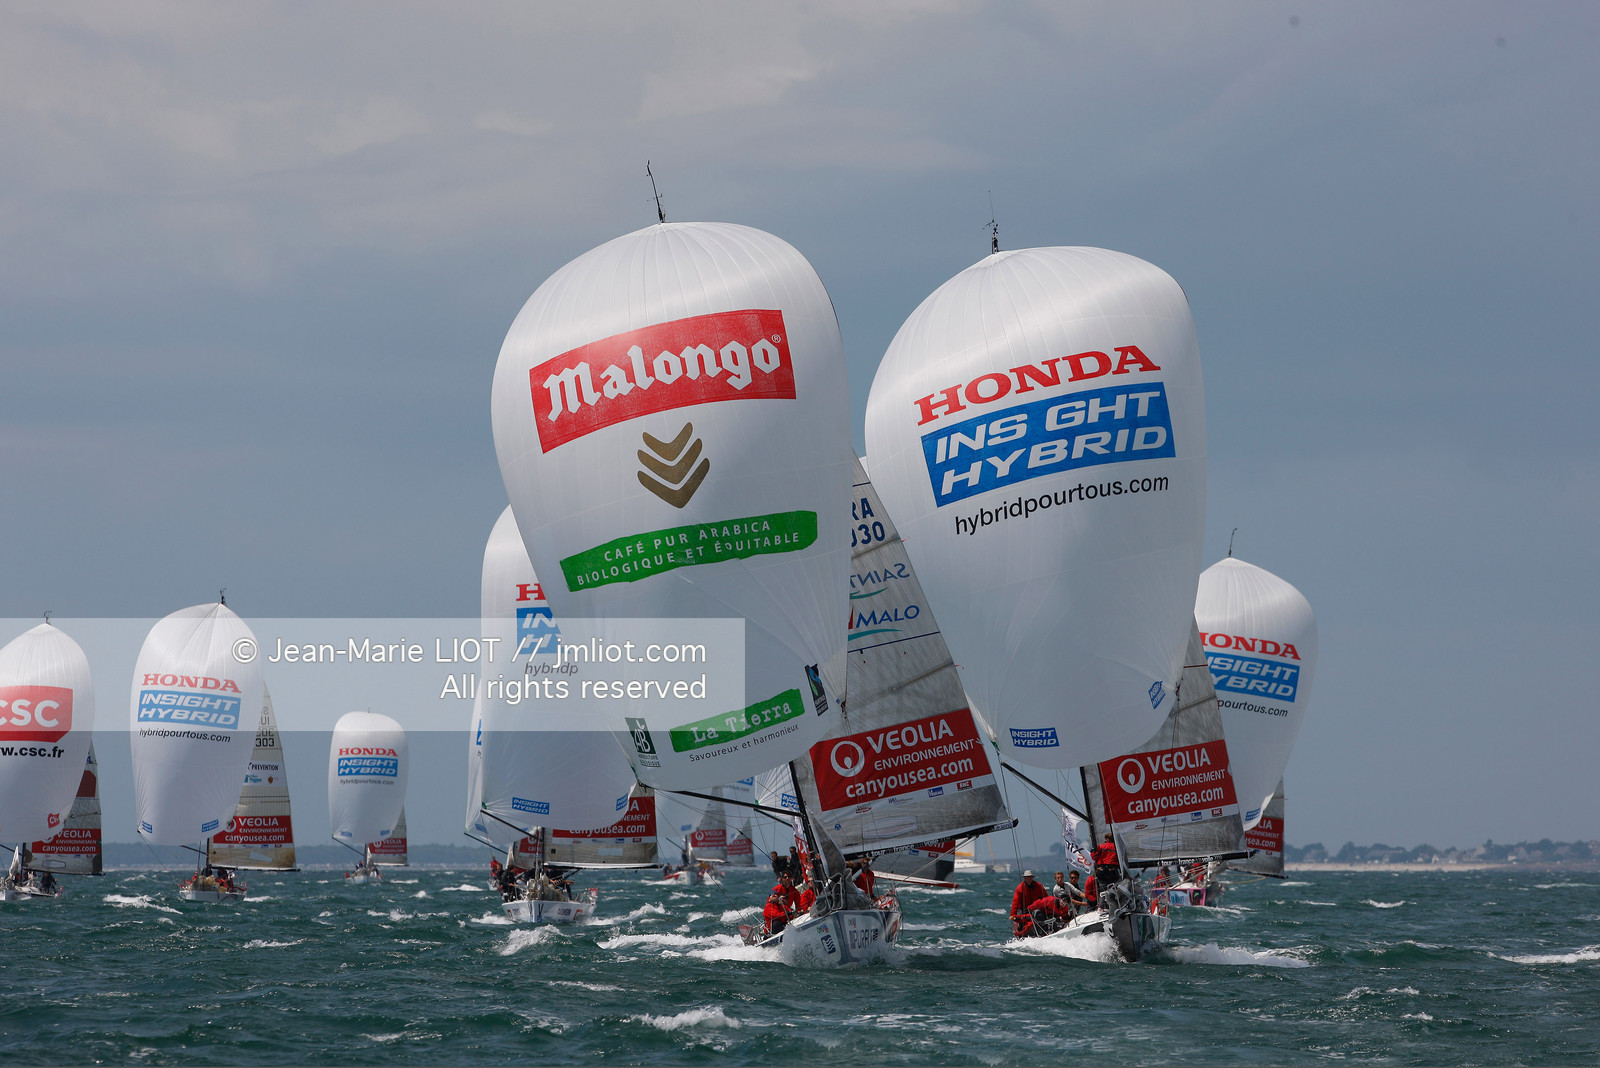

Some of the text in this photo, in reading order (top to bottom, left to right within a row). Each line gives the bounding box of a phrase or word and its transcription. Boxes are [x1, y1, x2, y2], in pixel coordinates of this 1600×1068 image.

[914, 345, 1161, 426] HONDA
[941, 426, 1167, 496] HYBRID
[955, 476, 1169, 535] hybridpourtous.com
[604, 520, 771, 562] CAFÉ PUR ARABICA
[577, 532, 799, 586] BIOLOGIQUE ET ÉQUITABLE
[856, 605, 920, 628] MALO
[142, 673, 241, 693] HONDA
[141, 693, 238, 711] INSIGHT
[139, 707, 235, 725] HYBRID
[690, 725, 719, 744] La
[724, 701, 792, 733] Tierra
[139, 728, 231, 743] hybridpourtous.com
[255, 737, 275, 747] 303
[689, 723, 800, 762] Savoureux et harmonieux
[866, 719, 953, 754] VEOLIA
[1012, 729, 1055, 739] INSIGHT
[1014, 737, 1057, 747] HYBRID
[339, 748, 398, 757] HONDA
[339, 758, 397, 767] INSIGHT
[874, 738, 975, 771] ENVIRONNEMENT
[1147, 747, 1211, 775] VEOLIA
[339, 767, 396, 775] HYBRID
[846, 756, 974, 799] canyousea.com
[1152, 769, 1226, 791] ENVIRONNEMENT
[512, 804, 549, 815] HYBRID
[1127, 786, 1224, 816] canyousea.com
[239, 817, 278, 827] VEOLIA
[57, 829, 91, 838] VEOLIA
[224, 834, 285, 844] canyousea.com
[42, 845, 96, 853] canyousea.com
